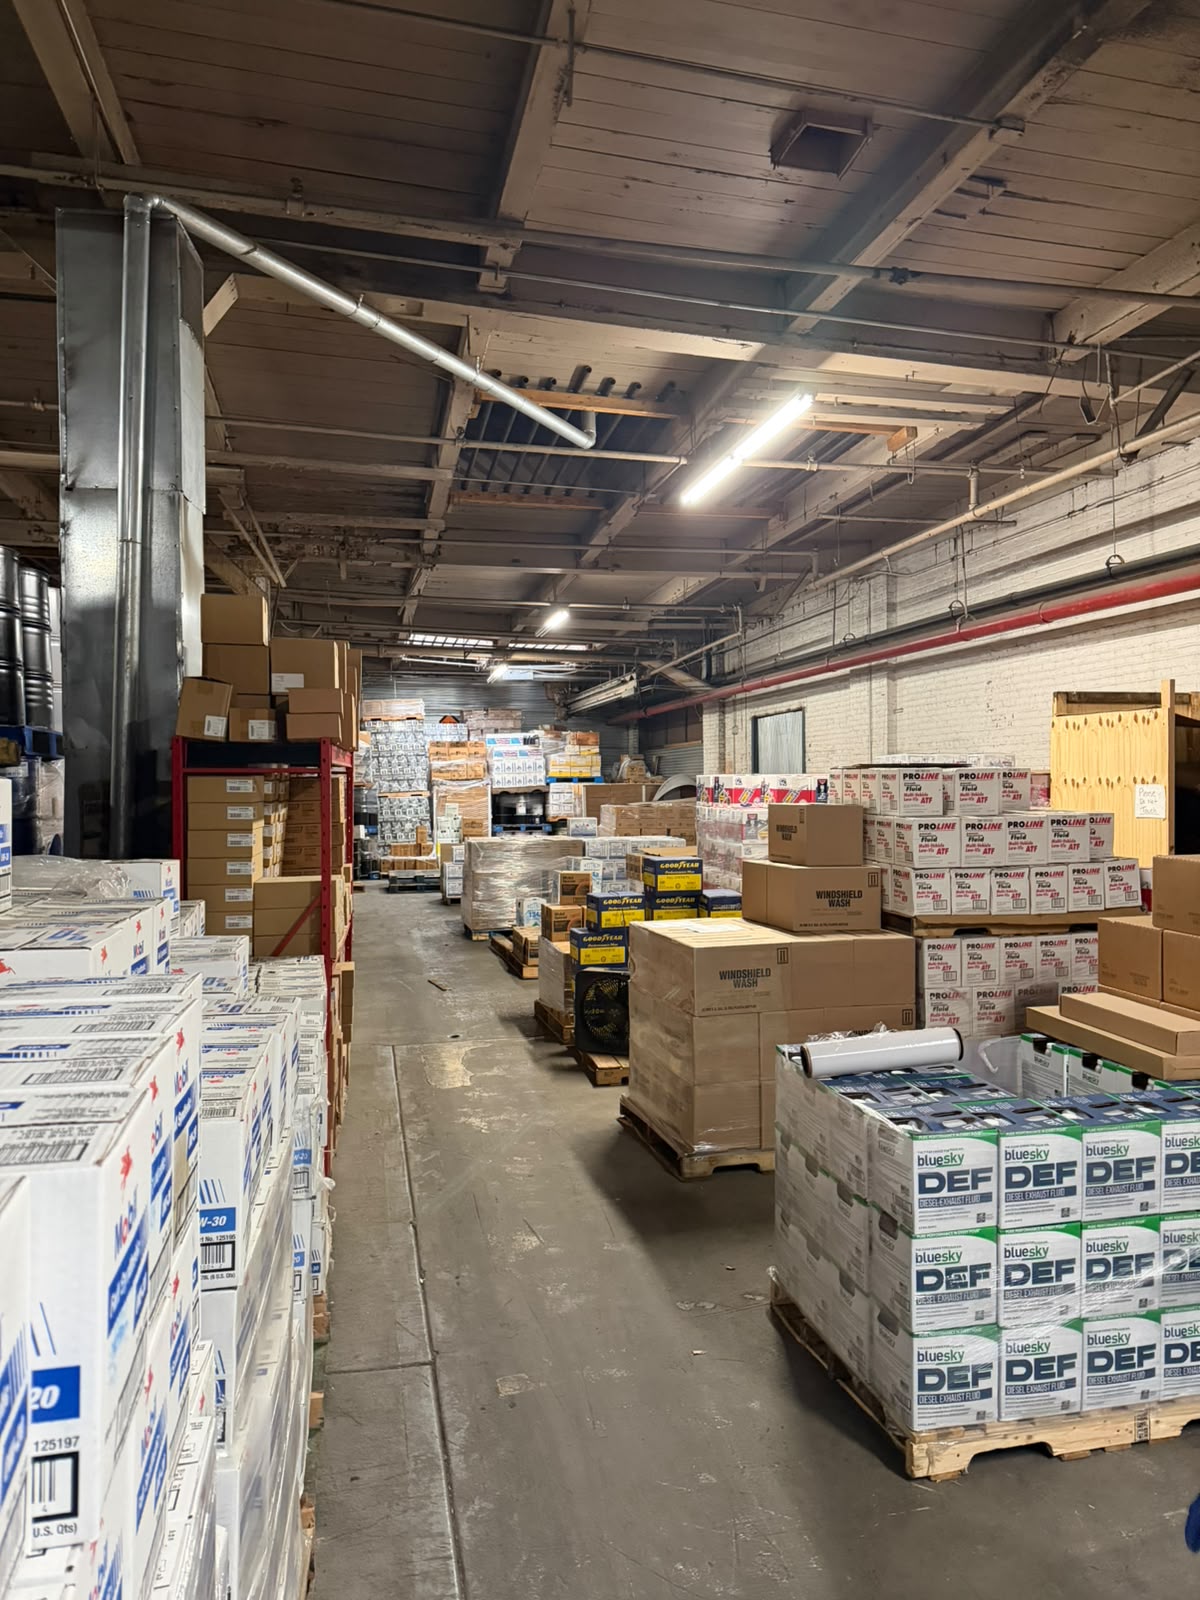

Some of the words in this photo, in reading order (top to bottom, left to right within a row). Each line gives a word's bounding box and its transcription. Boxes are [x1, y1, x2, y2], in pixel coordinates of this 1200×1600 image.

[903, 772, 940, 782] PROLINE
[959, 772, 995, 782] PROLINE
[1002, 771, 1028, 780] ROLINE
[920, 796, 933, 804] ATF
[976, 796, 989, 804] ATF
[1007, 820, 1045, 829] PROLINE
[1051, 818, 1087, 827] PROLINE
[1089, 817, 1112, 825] OLINE
[918, 822, 957, 832] PROLINE
[965, 822, 1003, 832] PROLINE
[1025, 845, 1038, 853] ATF
[1068, 843, 1080, 851] ATF
[660, 861, 699, 870] GOODYEAR
[1107, 864, 1136, 873] PROLINE
[915, 872, 945, 880] PROLINE
[955, 872, 986, 880] PROLINE
[994, 872, 1025, 880] PROLINE
[1035, 870, 1065, 879] PROLINE
[1072, 867, 1100, 876] PROLINE
[816, 889, 863, 899] WINDSHIELD
[603, 897, 642, 905] GOODYEAR
[656, 896, 695, 904] GOODYEAR
[828, 898, 851, 908] WASH
[582, 934, 623, 943] GOODYEAR
[1040, 939, 1068, 948] PROLINE
[927, 943, 957, 951] PROLINE
[966, 942, 996, 950] PROLINE
[1004, 941, 1033, 949] PROLINE
[719, 968, 771, 980] WINDSHIELD
[733, 978, 758, 989] WASH
[977, 989, 1013, 999] PROLINE
[1061, 984, 1096, 994] PROLINE
[1004, 1148, 1049, 1163] bluesky
[1086, 1144, 1129, 1159] bluesky
[917, 1152, 964, 1168] bluesky
[1005, 1160, 1078, 1189] DEF
[1086, 1156, 1156, 1185] DEF
[918, 1167, 993, 1195] DEF
[1086, 1240, 1129, 1255] bluesky
[916, 1250, 962, 1266] bluesky
[1004, 1246, 1049, 1261] bluesky
[1086, 1252, 1155, 1281] DEF
[916, 1262, 992, 1292] DEF
[1004, 1258, 1076, 1287] DEF
[1087, 1332, 1131, 1347] bluesky
[1005, 1341, 1050, 1357] bluesky
[917, 1349, 964, 1365] bluesky
[1087, 1343, 1156, 1373] DEF
[1005, 1353, 1077, 1382] DEF
[918, 1362, 993, 1392] DEF
[33, 1436, 80, 1453] 125197
[33, 1526, 53, 1538] U.S.
[56, 1522, 77, 1535] Qts)
